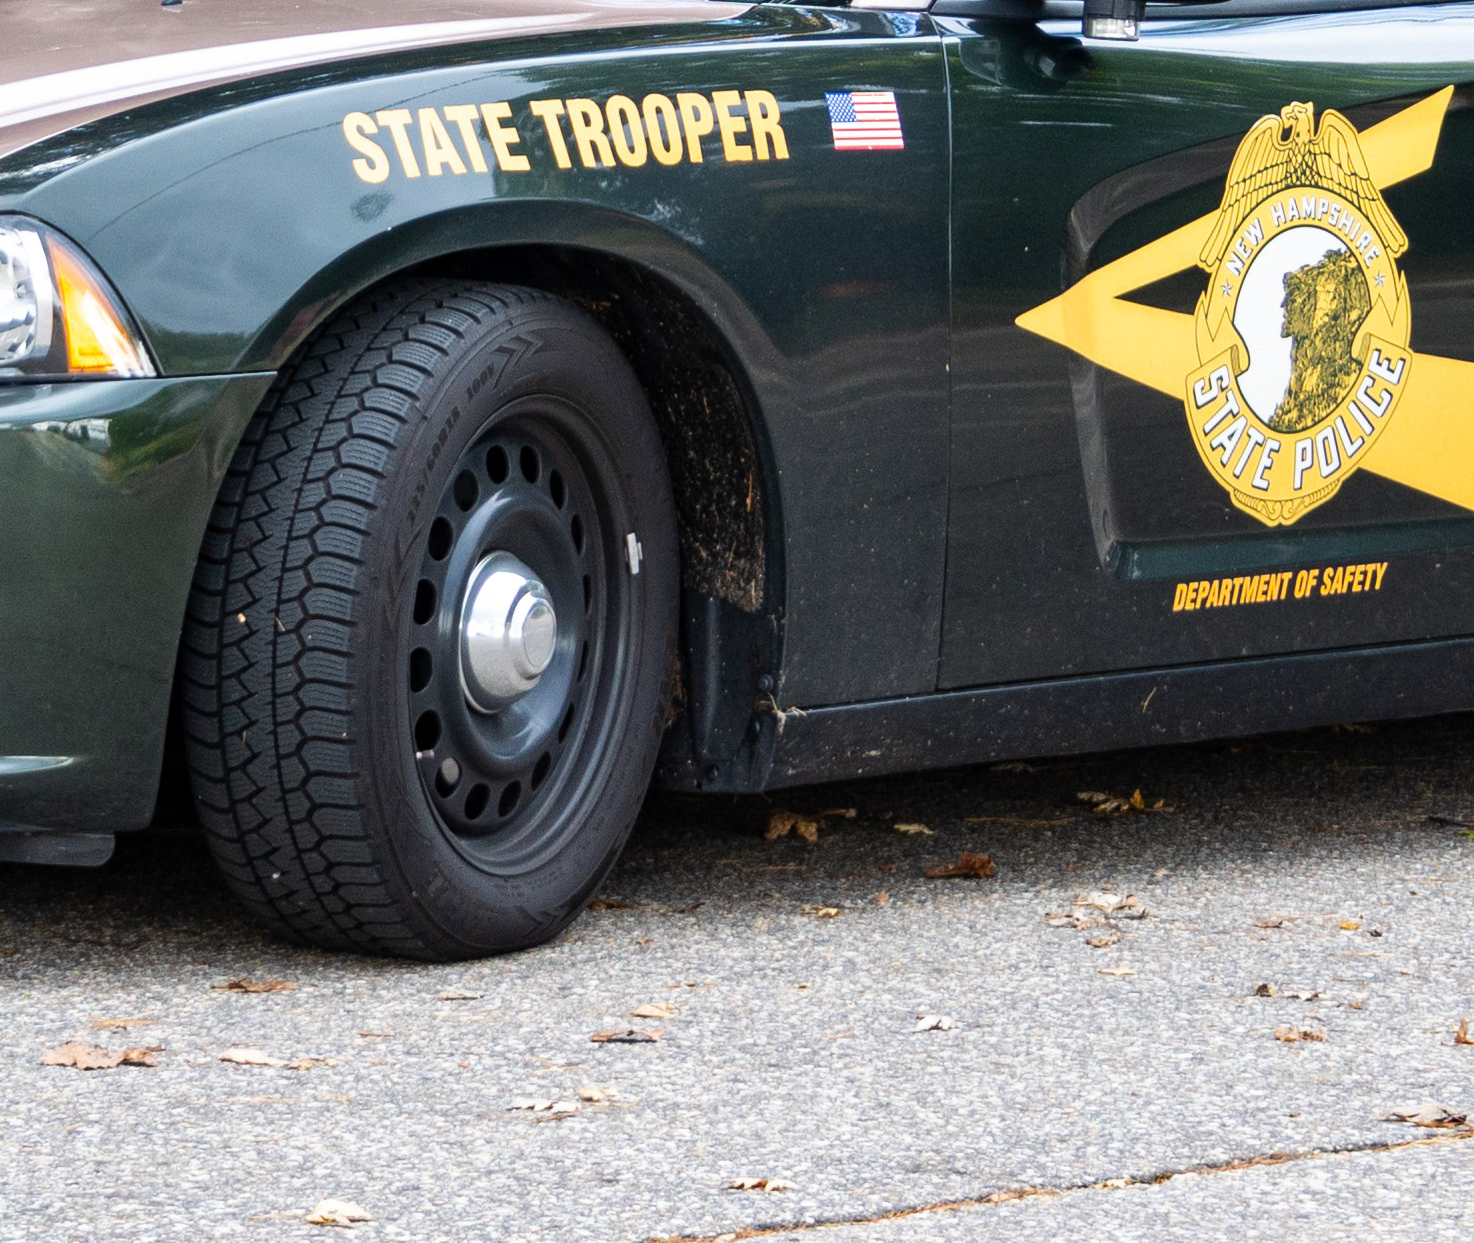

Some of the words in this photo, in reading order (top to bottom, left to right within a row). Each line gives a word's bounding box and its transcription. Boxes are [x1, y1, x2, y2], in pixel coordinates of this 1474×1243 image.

[342, 102, 531, 184] STATE
[530, 90, 790, 169] TROOPER
[1225, 218, 1265, 277] NEW
[1270, 195, 1380, 269] HAMPSHIRE
[1193, 364, 1281, 491] STATE
[1293, 348, 1406, 491] POLICE
[1173, 572, 1293, 612] DEPARTMENT
[1294, 569, 1320, 599] OF
[1320, 562, 1388, 595] SAFETY
